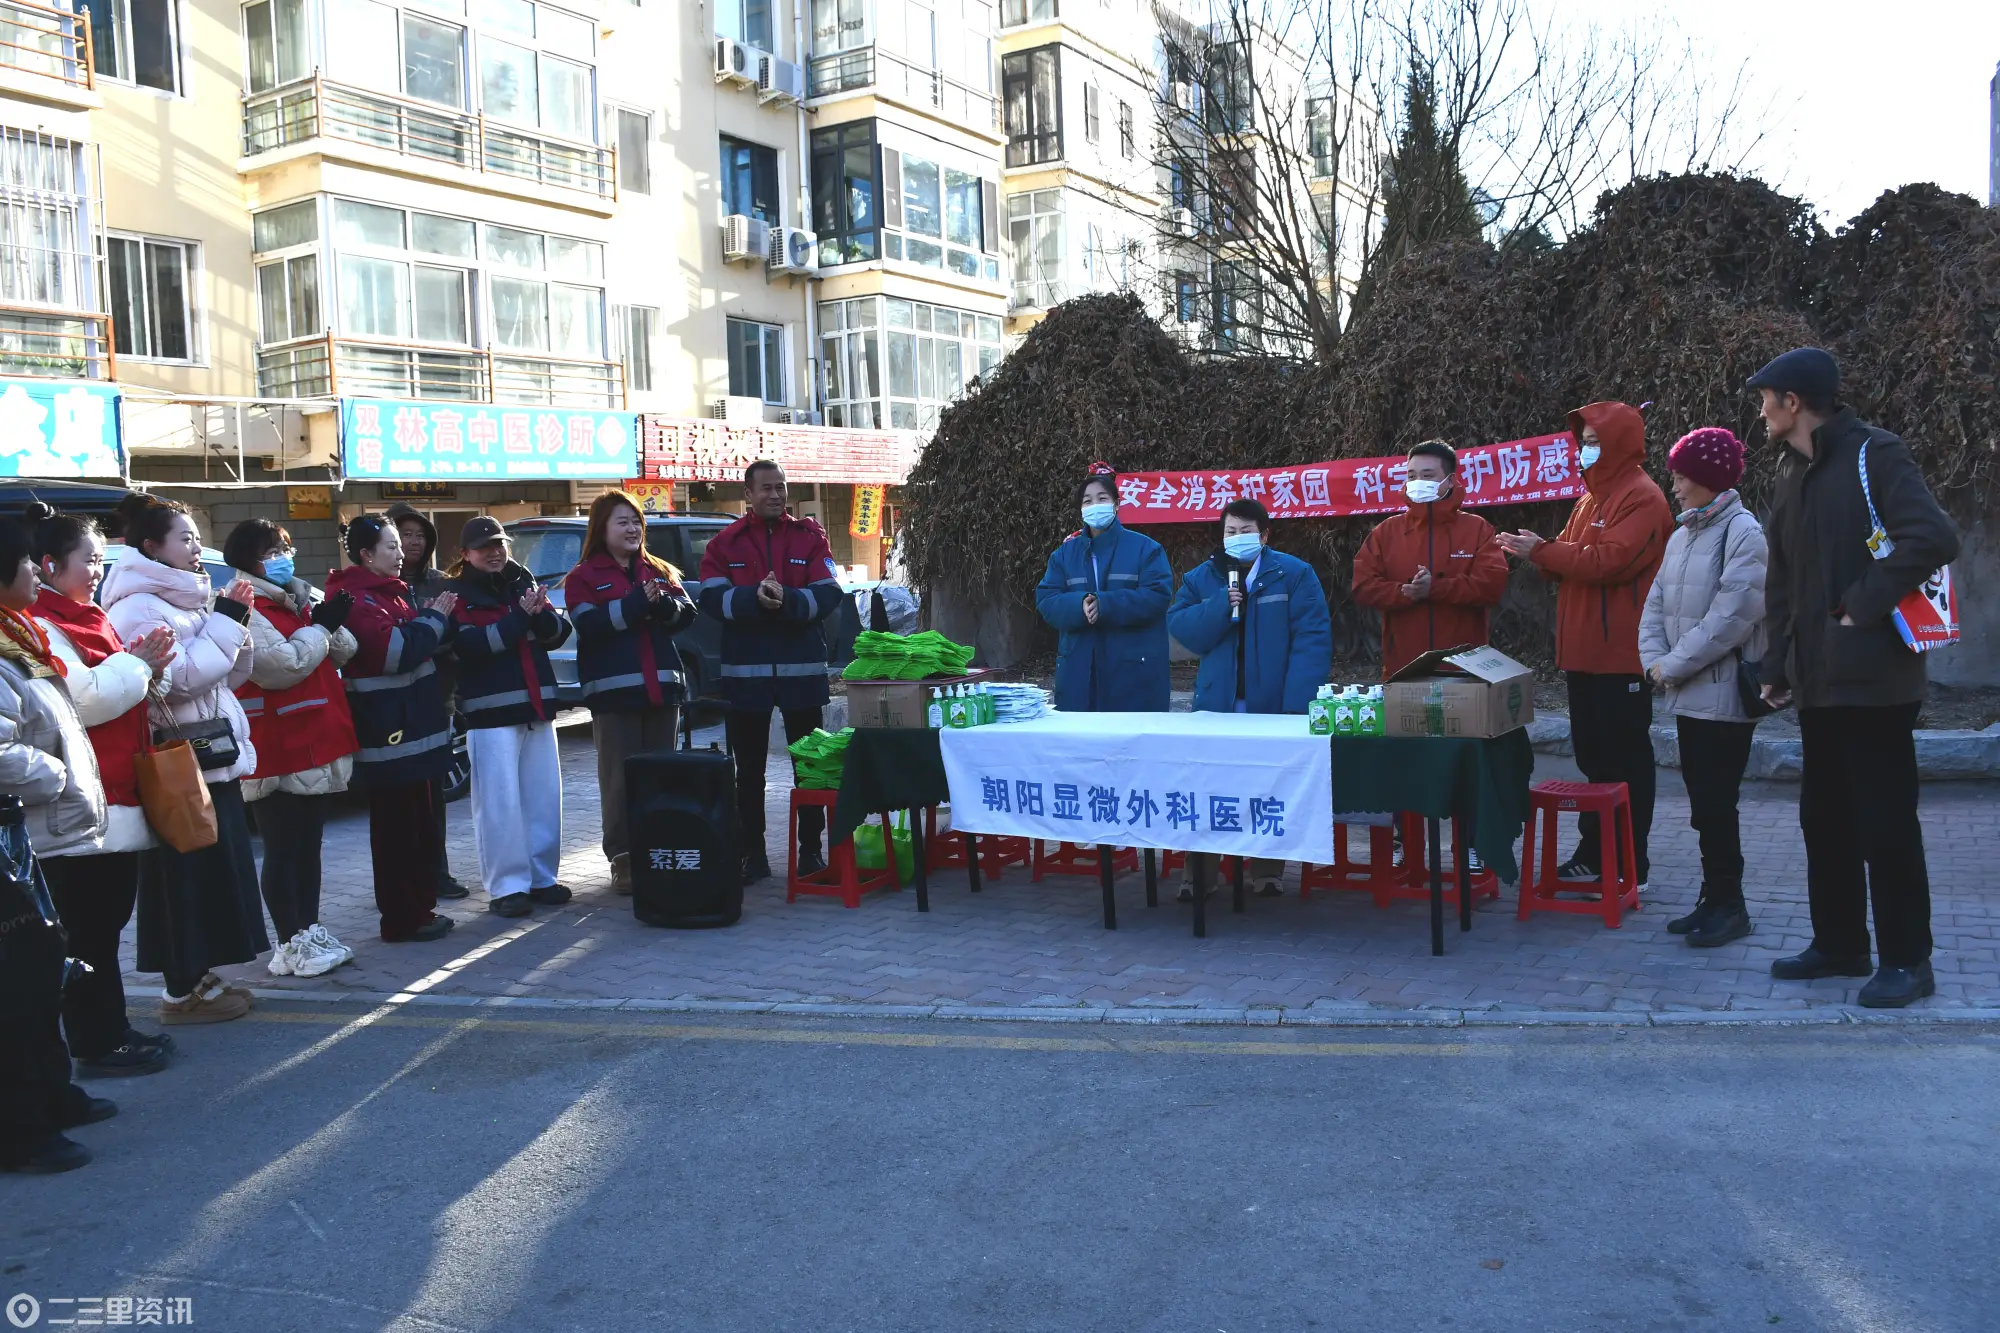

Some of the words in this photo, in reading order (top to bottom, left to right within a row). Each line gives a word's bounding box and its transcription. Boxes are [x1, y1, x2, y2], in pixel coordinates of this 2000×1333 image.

[355, 404, 384, 473] 双塔
[393, 406, 596, 456] 林高中医诊所
[1118, 468, 1332, 511] 安全消杀护家园
[980, 776, 1286, 837] 朝阳显微外科医院
[649, 848, 701, 870] 索爱
